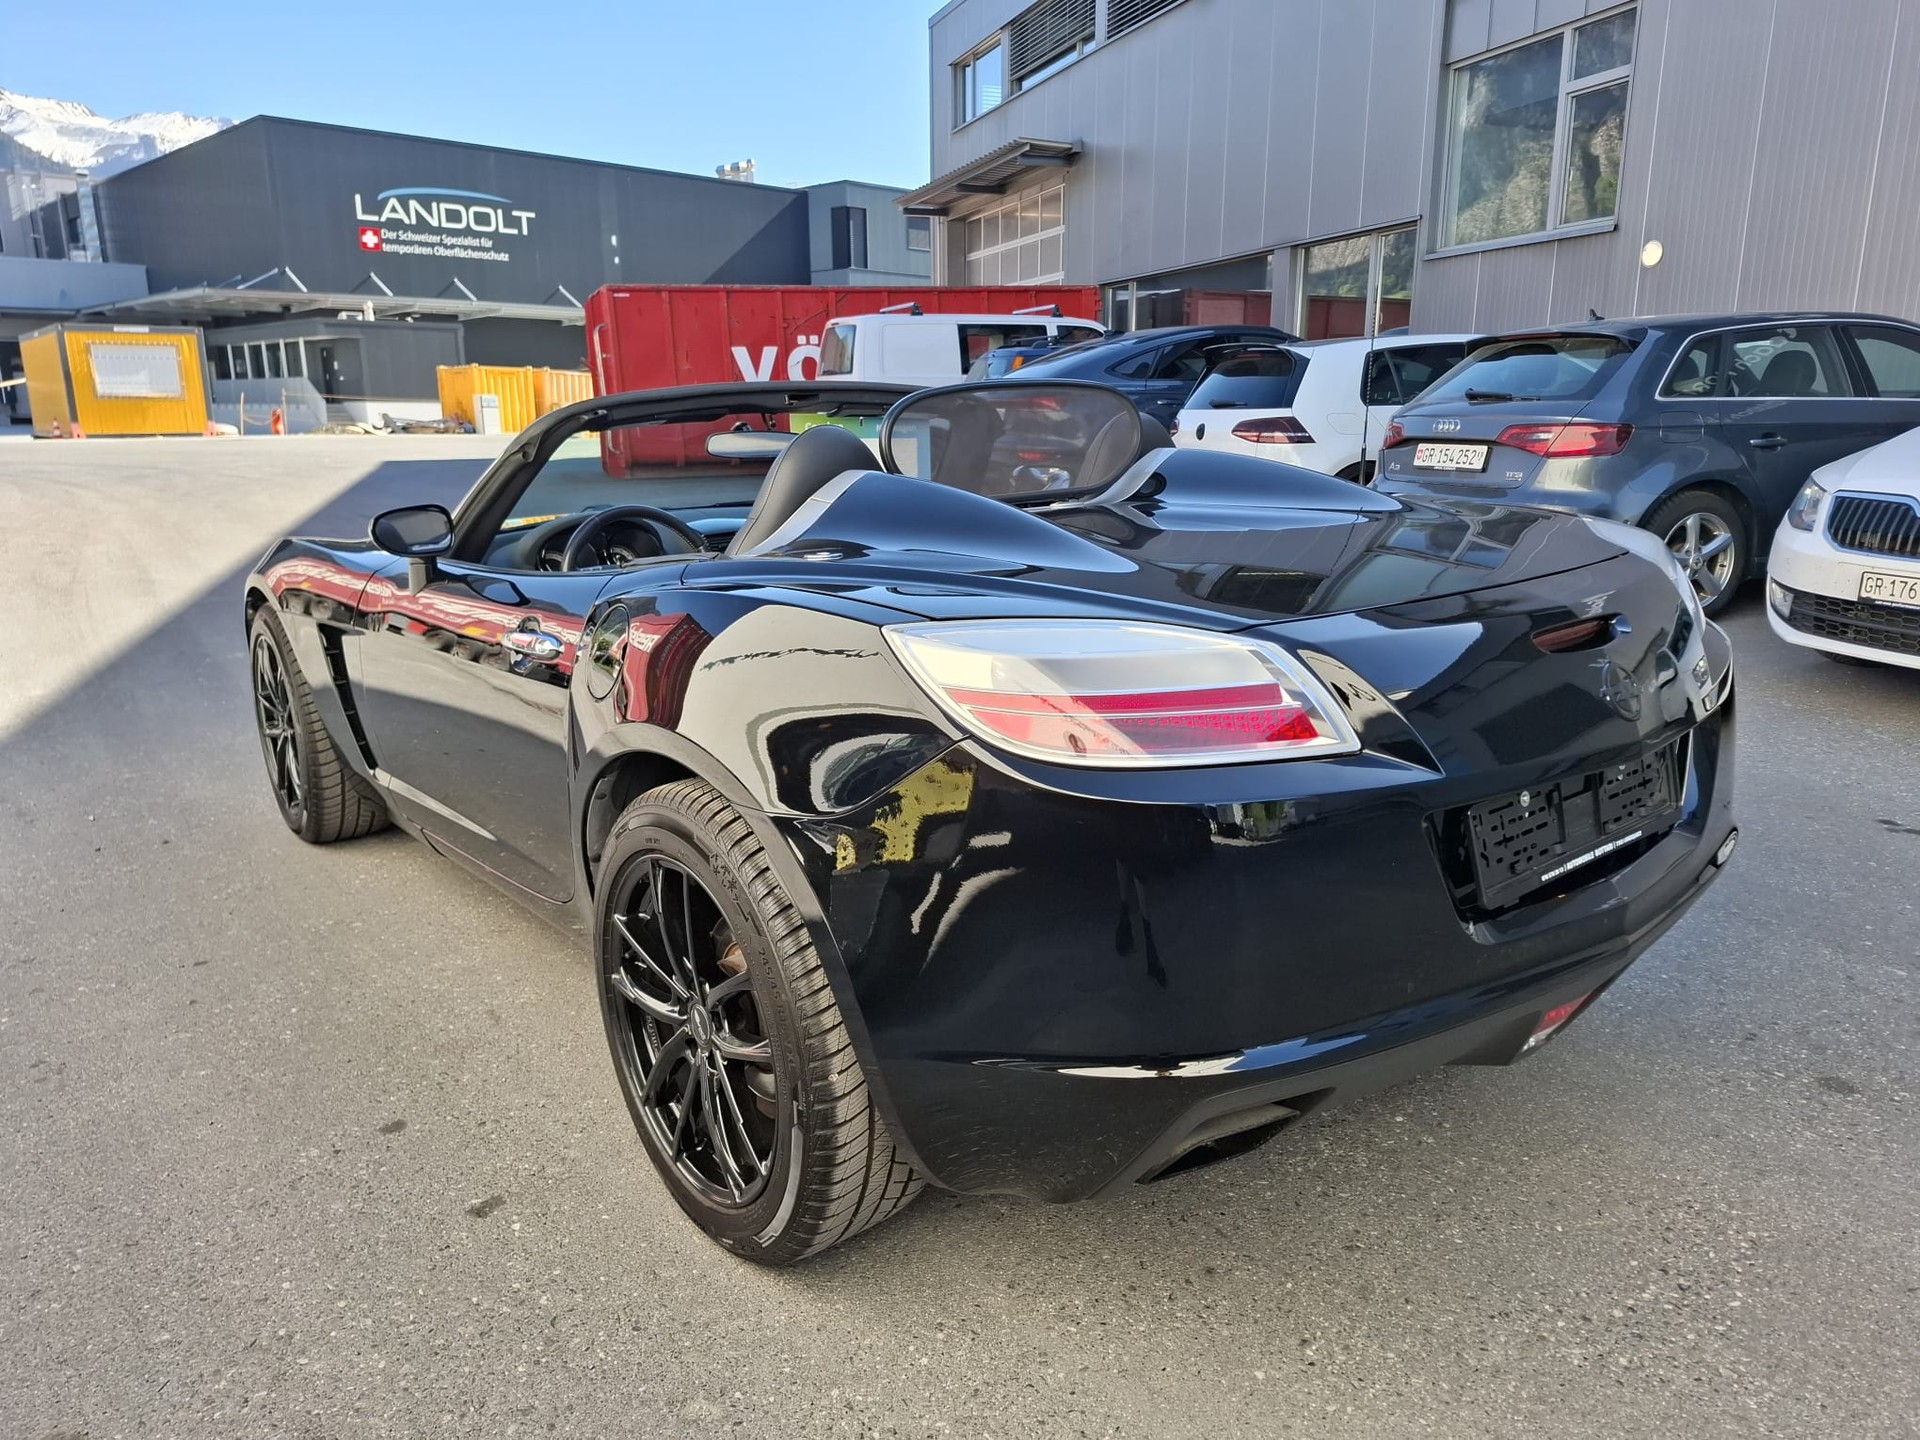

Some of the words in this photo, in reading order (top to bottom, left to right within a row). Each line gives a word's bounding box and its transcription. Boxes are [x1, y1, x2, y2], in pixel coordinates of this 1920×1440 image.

[354, 194, 536, 235] LANDOLT
[381, 229, 397, 240] Der
[398, 230, 441, 244] Schweizer
[441, 234, 480, 248] Spezialist
[481, 236, 493, 248] für
[382, 242, 433, 255] temporären
[434, 245, 510, 262] Oberflächenschutz
